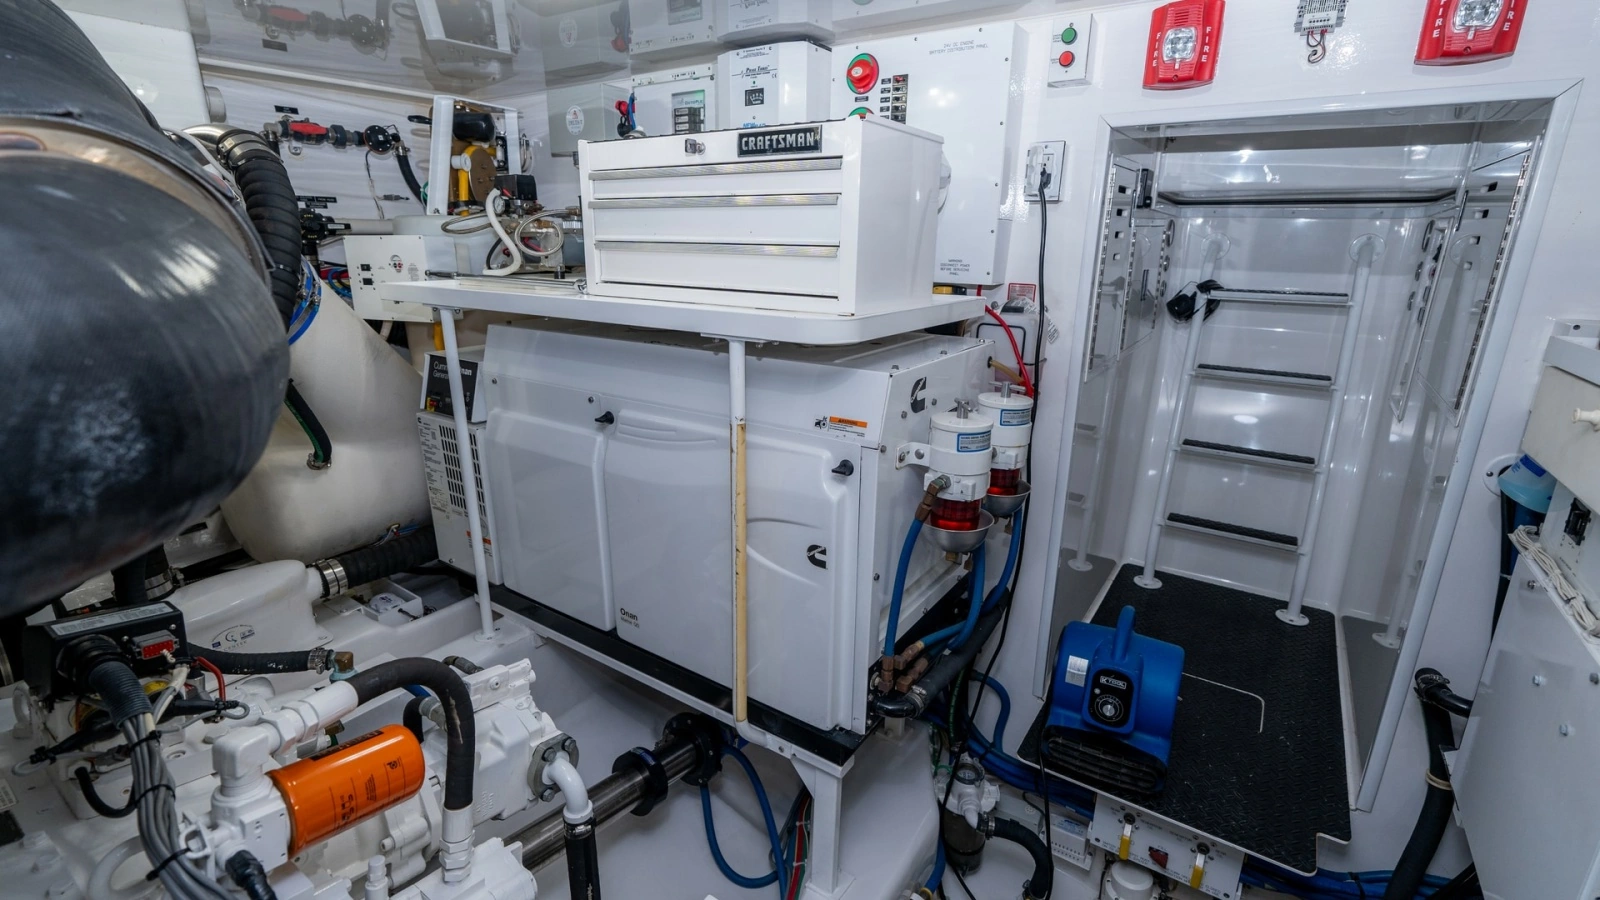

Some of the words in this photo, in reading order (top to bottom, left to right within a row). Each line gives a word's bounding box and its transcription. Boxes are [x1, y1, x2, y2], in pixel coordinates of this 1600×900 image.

[1502, 0, 1515, 31] IRE
[1152, 32, 1162, 67] FIRE
[1201, 26, 1212, 62] FIRE
[741, 132, 815, 151] CRAFTSMAN
[433, 361, 448, 370] Cumm
[460, 368, 472, 376] nan
[620, 608, 638, 621] Onan
